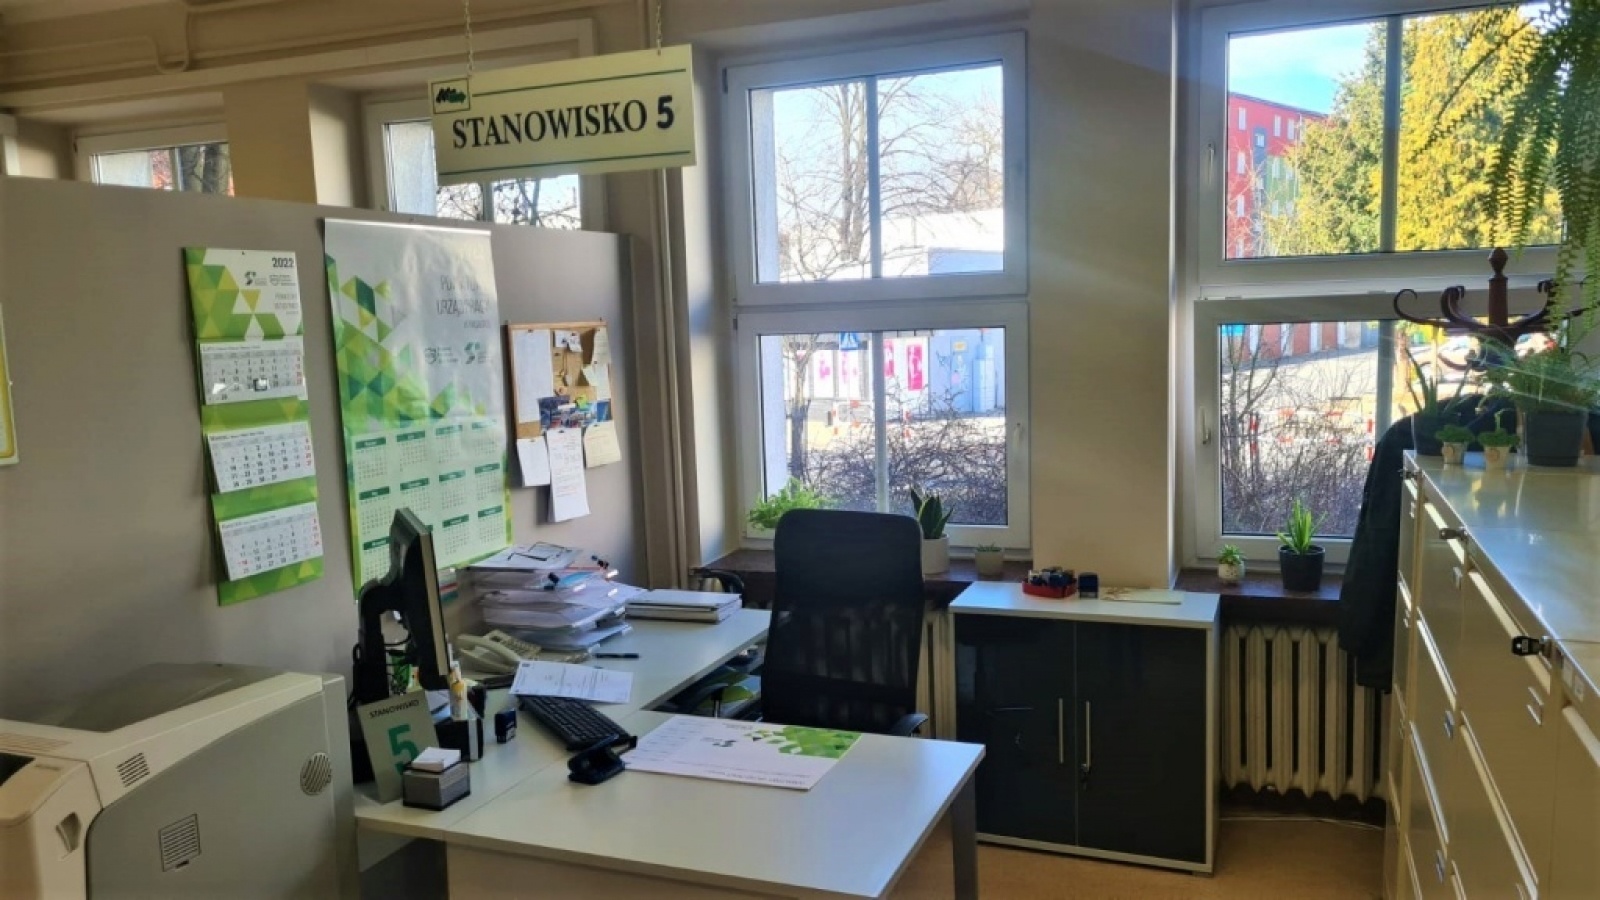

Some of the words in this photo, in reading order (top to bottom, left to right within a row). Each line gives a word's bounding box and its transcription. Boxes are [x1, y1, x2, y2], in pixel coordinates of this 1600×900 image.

[453, 100, 647, 148] STANOWISKO
[656, 95, 675, 130] 5
[272, 257, 294, 268] 2022
[370, 699, 419, 718] STANOWISKO
[387, 724, 418, 776] 5
